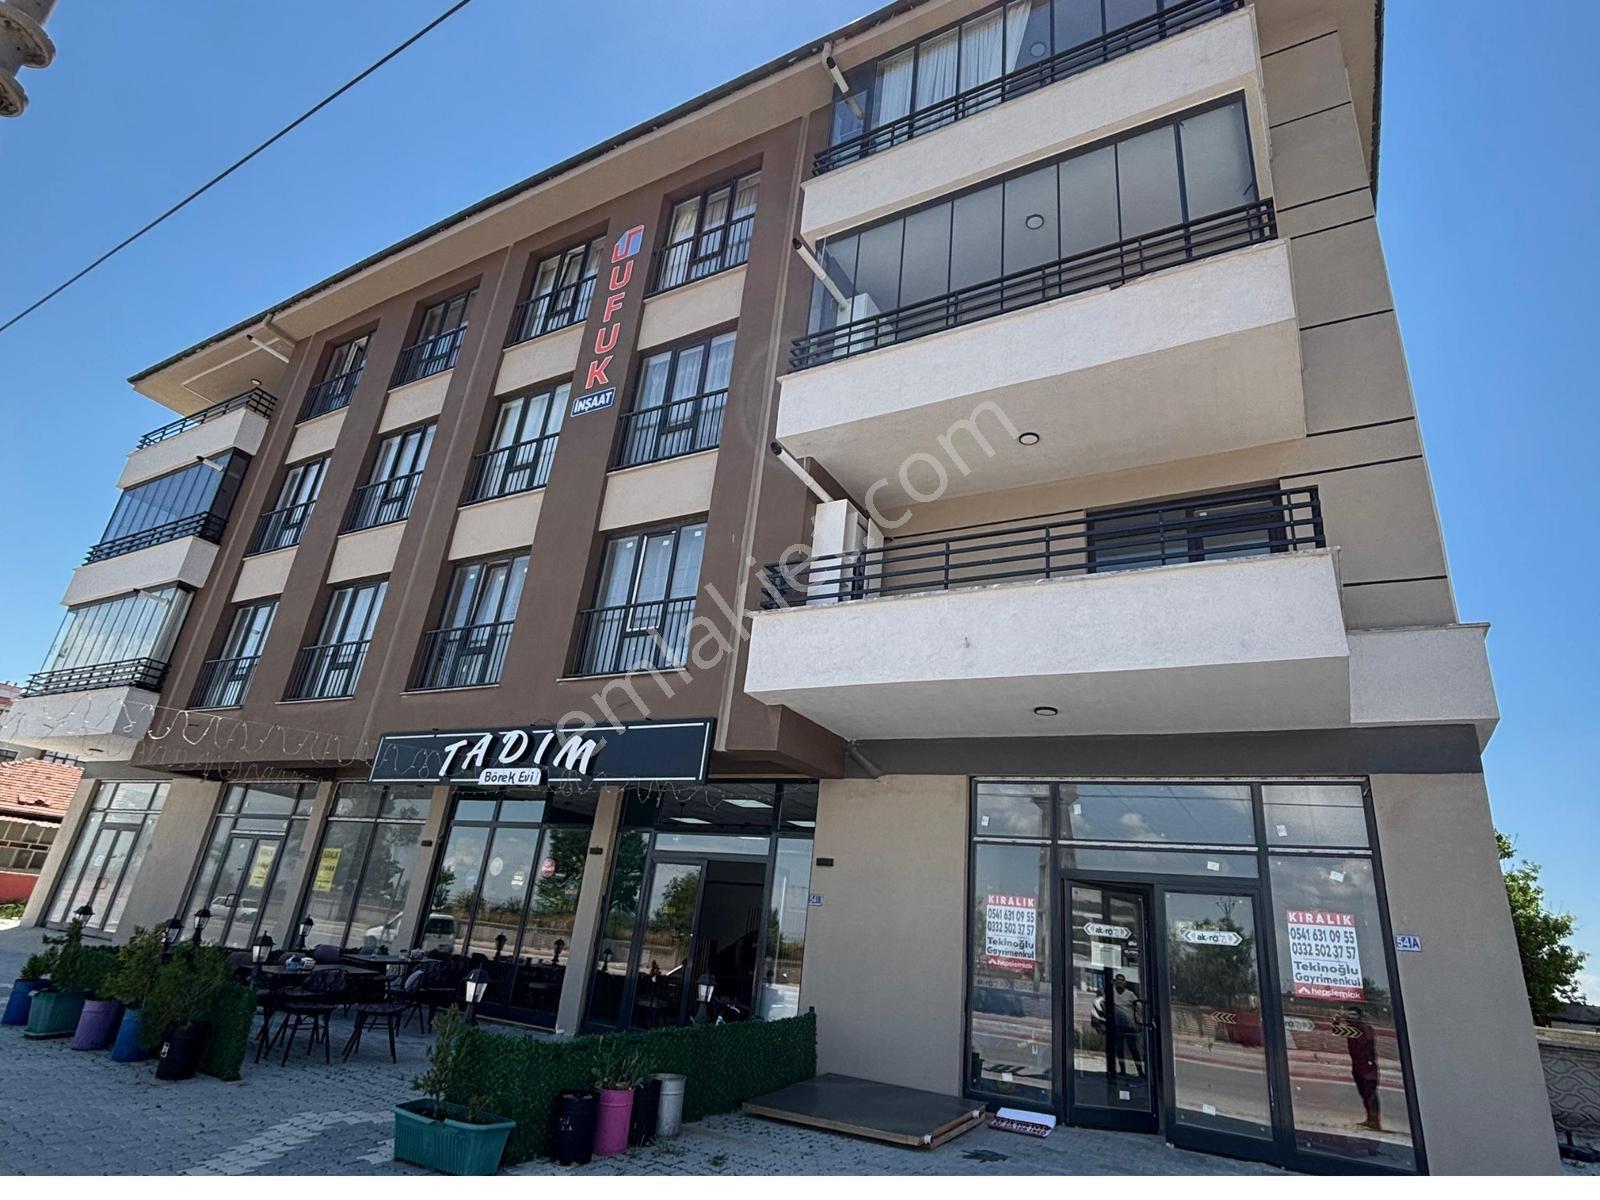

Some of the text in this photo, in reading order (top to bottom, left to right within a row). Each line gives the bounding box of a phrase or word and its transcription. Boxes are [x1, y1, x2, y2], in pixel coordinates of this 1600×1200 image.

[585, 260, 634, 390] UFUK
[439, 730, 597, 775] TADIM
[518, 771, 535, 783] Evi
[1290, 927, 1355, 944] 0541 631 09 55
[1292, 942, 1356, 960] 0332 502 37 57
[1294, 961, 1358, 976] Tekinoğlu
[1295, 973, 1361, 987] Gayrimenkul
